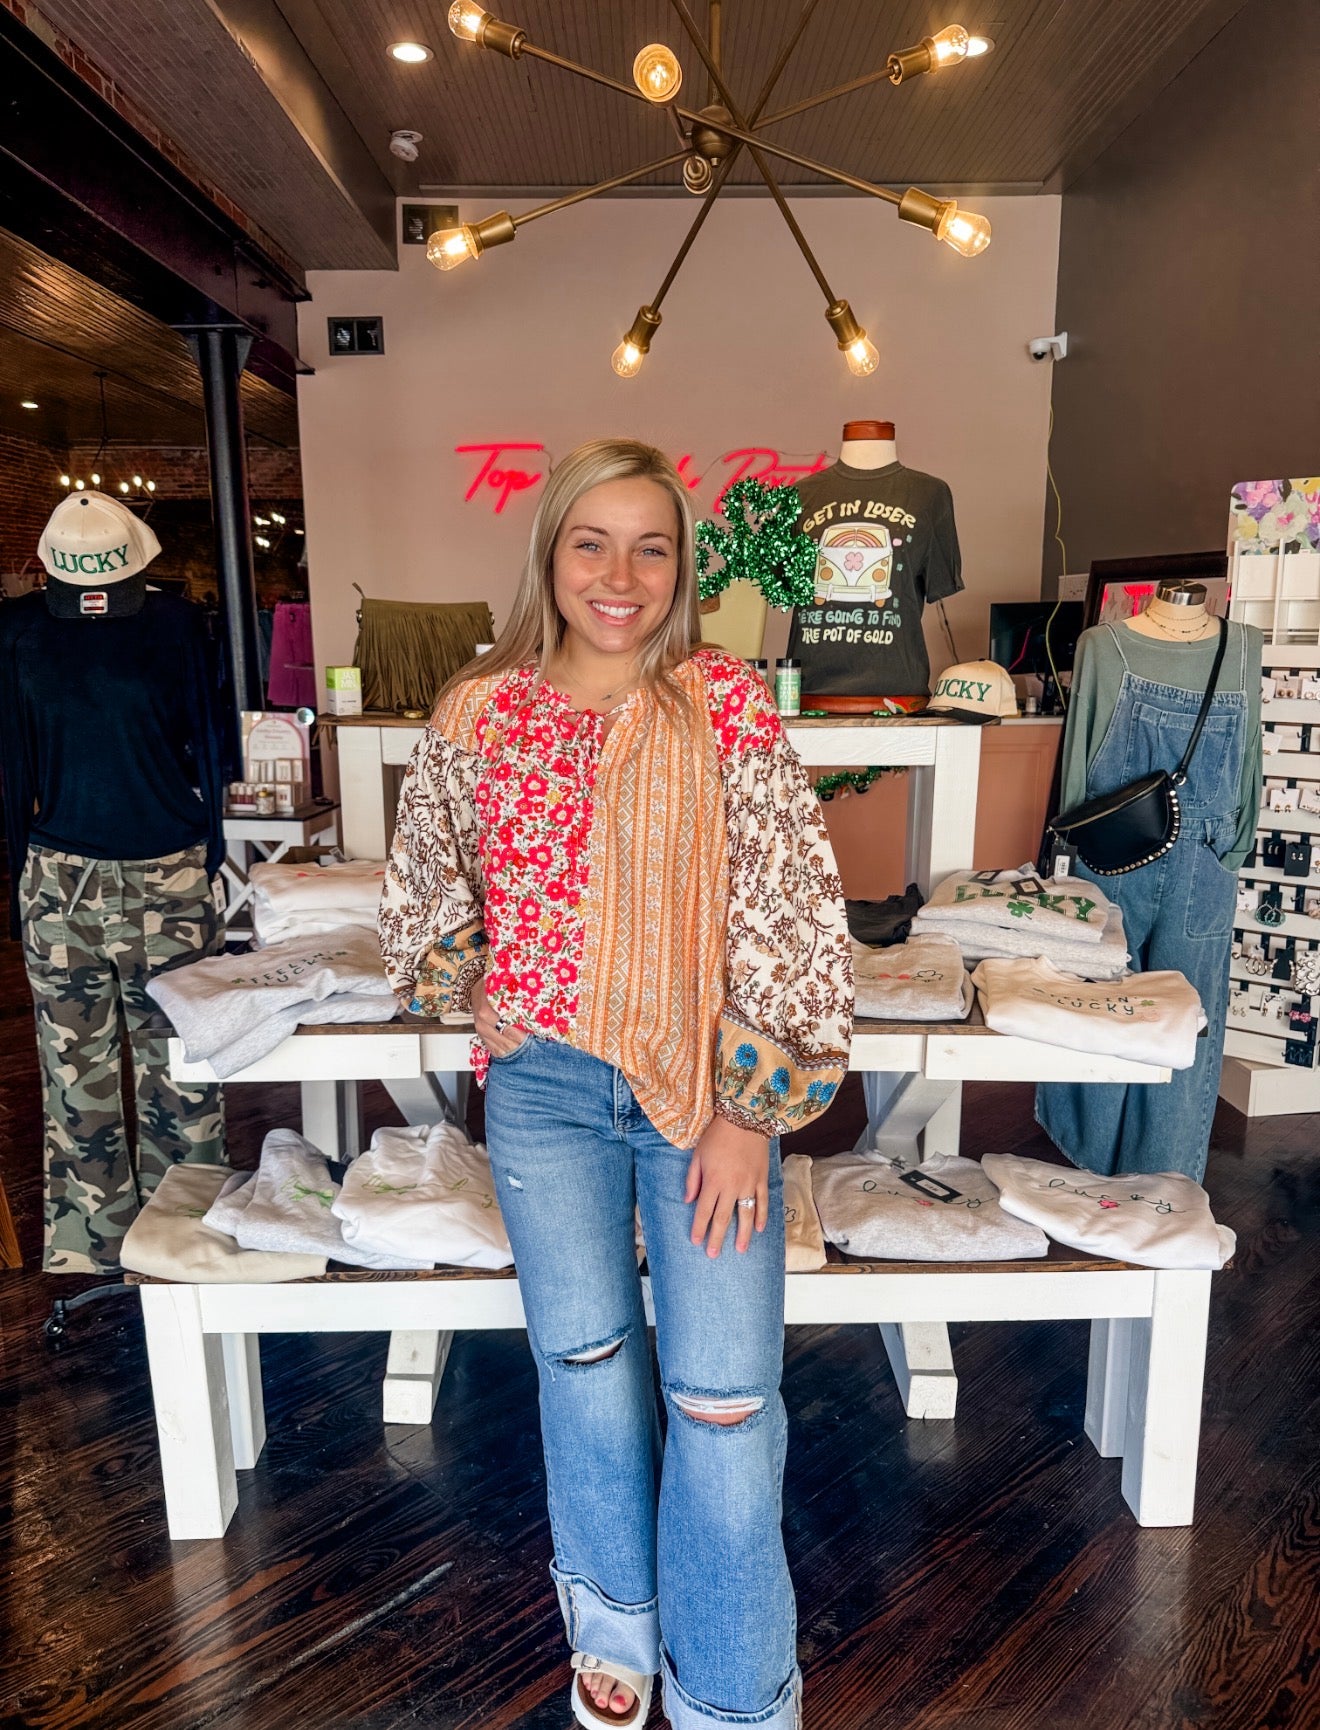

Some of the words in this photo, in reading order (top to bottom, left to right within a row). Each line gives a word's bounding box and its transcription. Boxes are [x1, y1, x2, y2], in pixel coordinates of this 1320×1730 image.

[455, 443, 545, 514] Top
[802, 501, 838, 533] GET
[839, 500, 862, 517] IN
[863, 500, 917, 529] LOSER
[50, 543, 129, 574] LUCKY
[825, 608, 864, 625] GOING
[867, 609, 880, 626] TO
[801, 627, 821, 644] THE
[822, 626, 846, 642] POT
[846, 628, 863, 644] OF
[863, 629, 894, 645] GOLD
[1056, 999, 1135, 1016] LUCKY
